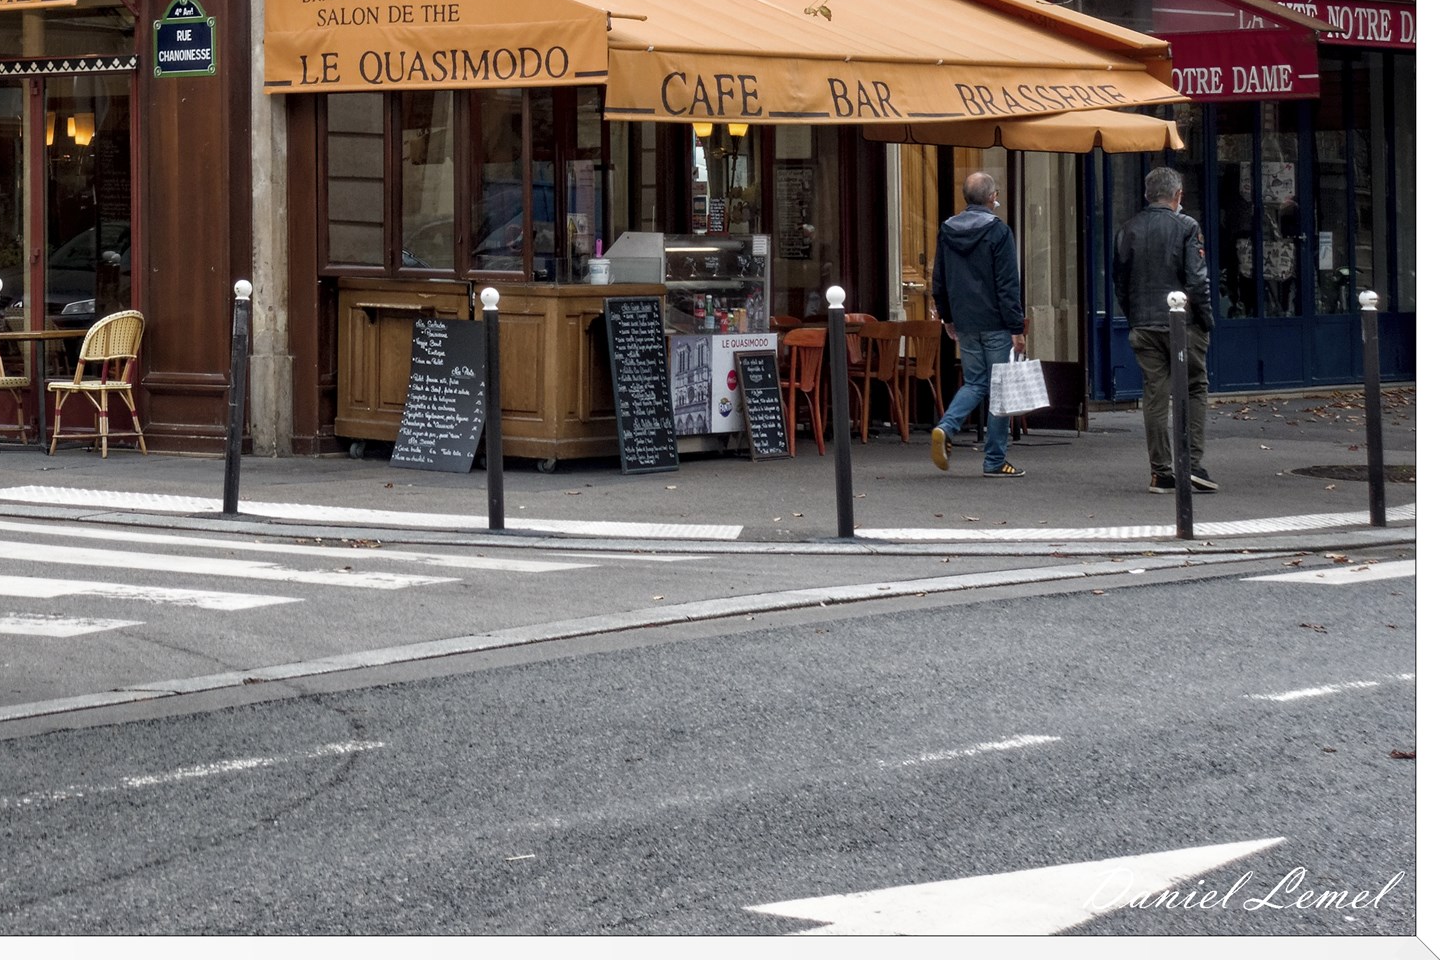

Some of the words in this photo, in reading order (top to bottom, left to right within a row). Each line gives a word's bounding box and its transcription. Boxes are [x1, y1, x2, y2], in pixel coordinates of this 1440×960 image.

[317, 6, 380, 27] SALON
[388, 5, 414, 23] DE
[420, 4, 460, 22] THE
[1327, 4, 1392, 43] NOTRE
[176, 29, 192, 42] RUE
[159, 48, 211, 62] CHANOINESSE
[299, 52, 341, 85] LE
[359, 45, 569, 85] QUASIMODO
[1171, 66, 1224, 95] OTRE
[1232, 64, 1293, 93] DAME
[661, 71, 763, 117] CAFE
[827, 77, 901, 118] BAR
[954, 82, 1125, 117] BRASSERIE
[722, 340, 729, 348] LE
[731, 338, 769, 348] QUASIMODO
